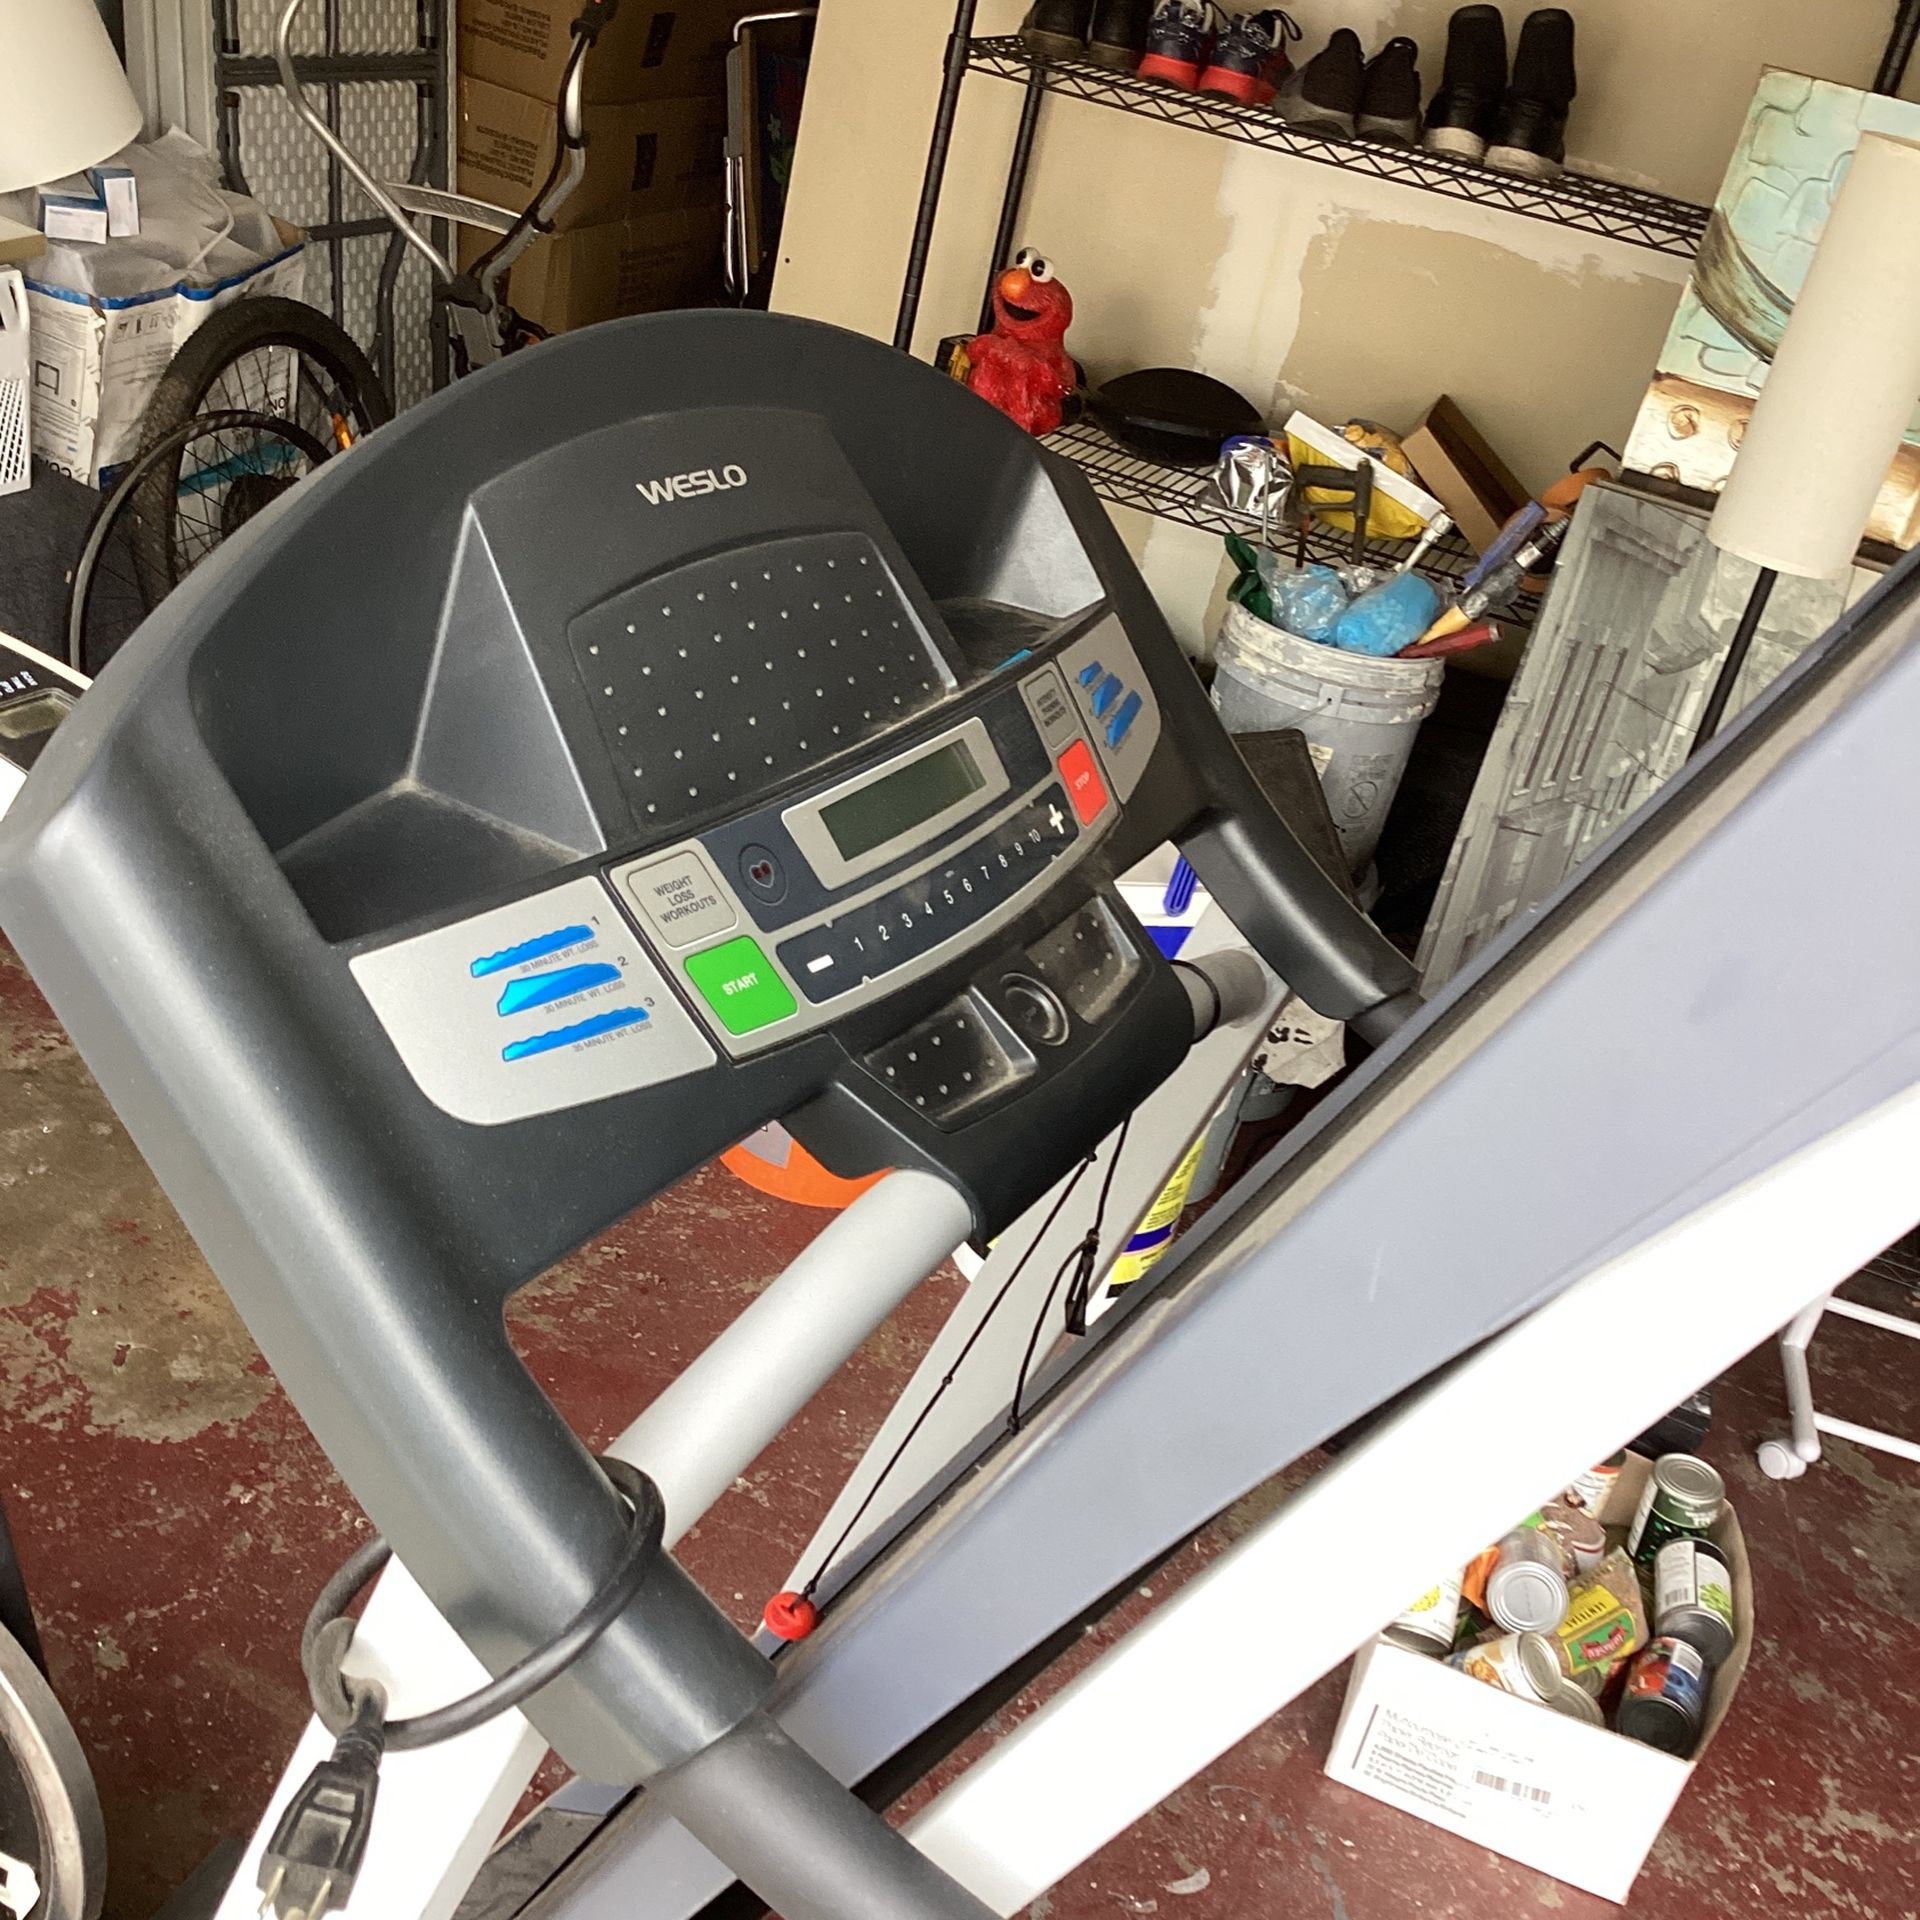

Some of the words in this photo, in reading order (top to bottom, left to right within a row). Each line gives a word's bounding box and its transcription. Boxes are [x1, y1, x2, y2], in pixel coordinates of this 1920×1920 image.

[636, 464, 748, 505] WESLO
[1074, 770, 1090, 791] STOP
[653, 875, 693, 897] WEIGHT
[667, 889, 696, 907] LOSS
[854, 936, 864, 951] 1
[878, 925, 890, 941] 2
[901, 912, 913, 928] 3
[924, 901, 934, 915] 4
[943, 889, 954, 904] 5
[962, 878, 973, 892] 6
[980, 865, 990, 880] 7
[998, 854, 1008, 868] 8
[1014, 842, 1024, 856] 9
[1028, 829, 1041, 843] 10
[591, 915, 600, 925] 1
[660, 895, 717, 923] WORKOUTS
[530, 951, 563, 970] MINUTE
[577, 940, 599, 954] LOSS
[617, 955, 629, 967] 2
[554, 995, 587, 1011] MINUTE
[603, 980, 626, 994] LOSS
[722, 972, 759, 996] START
[643, 996, 655, 1008] 3
[582, 1033, 616, 1049] MINUTE
[631, 1020, 653, 1034] LOSS
